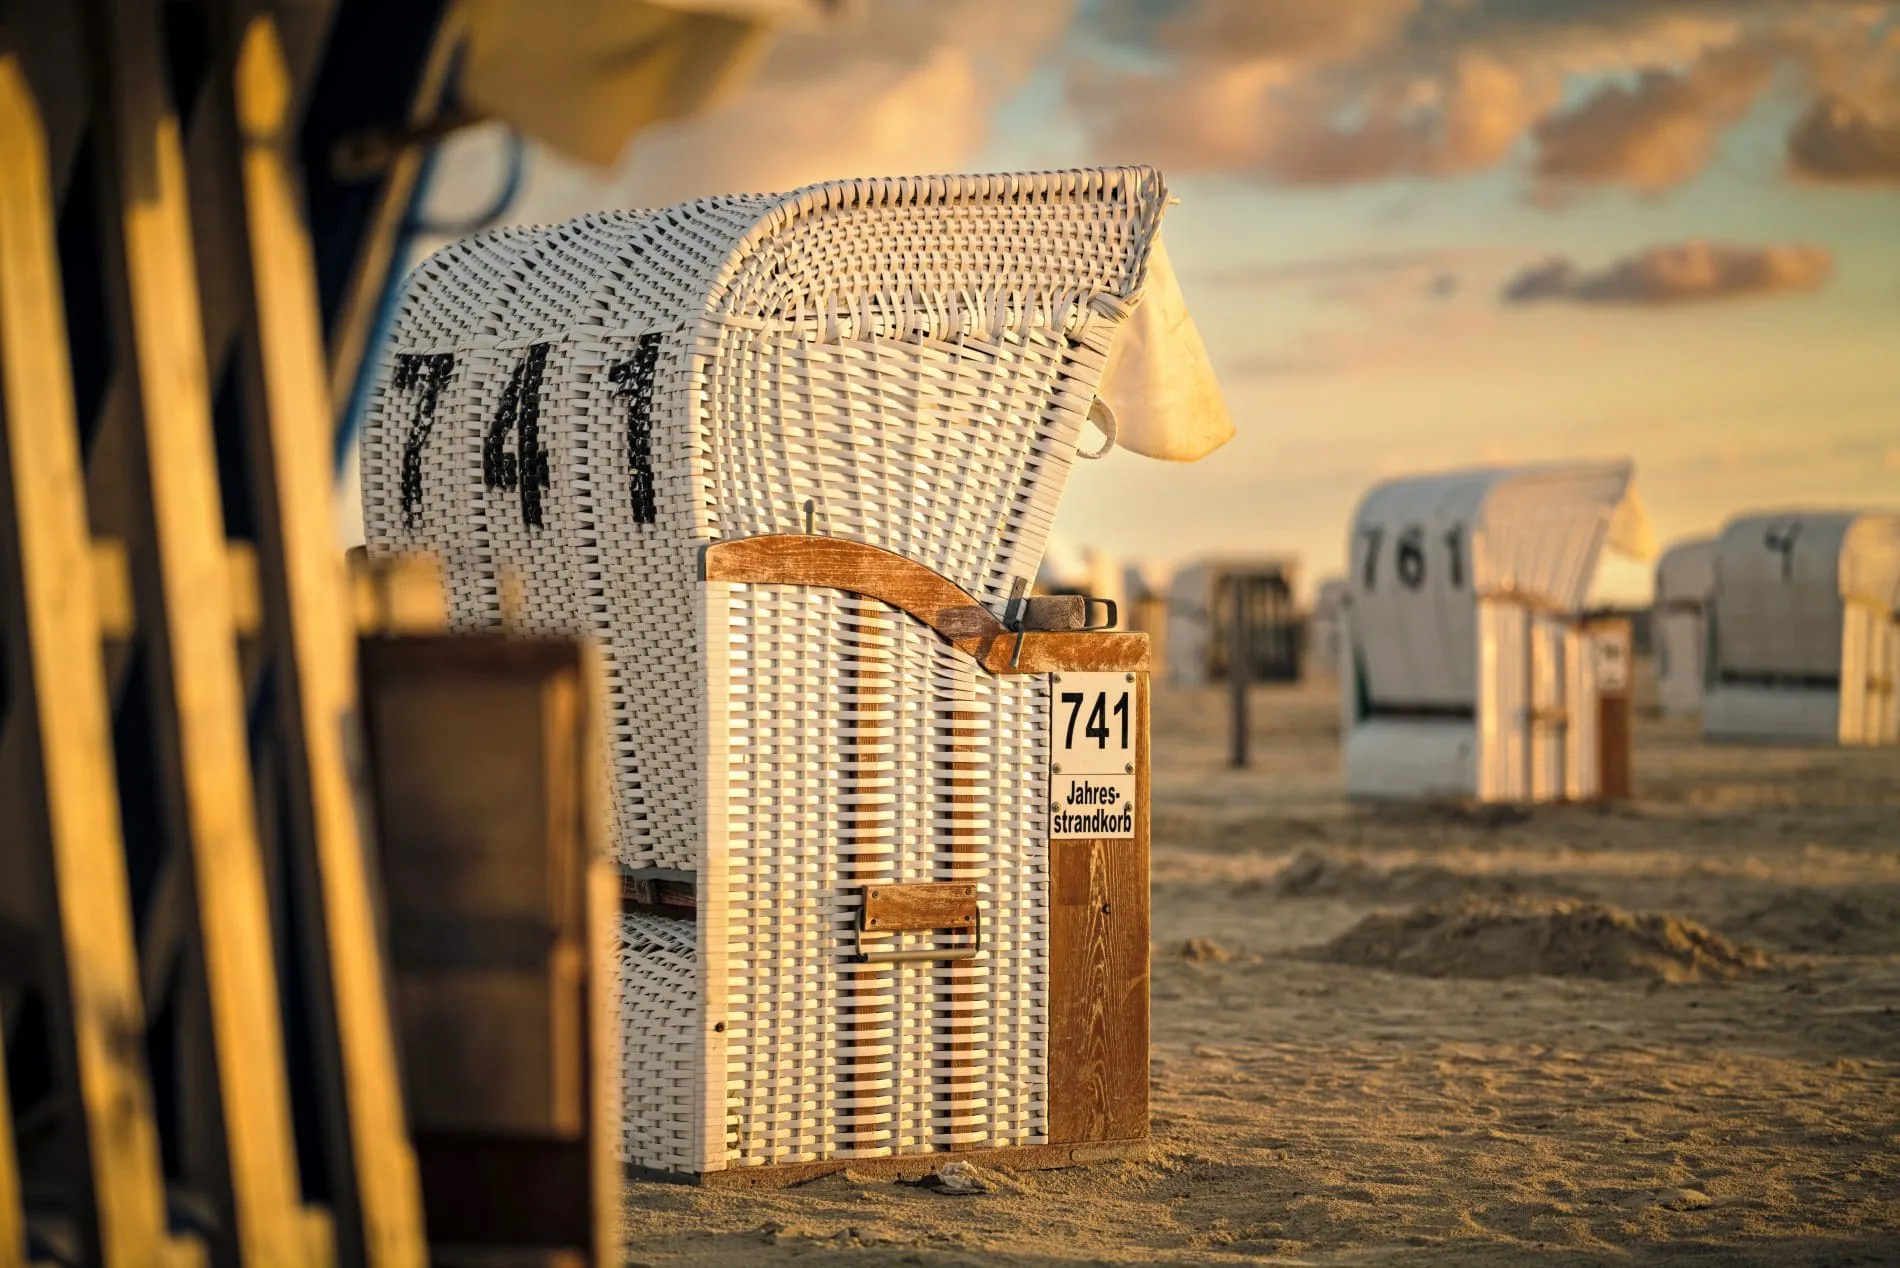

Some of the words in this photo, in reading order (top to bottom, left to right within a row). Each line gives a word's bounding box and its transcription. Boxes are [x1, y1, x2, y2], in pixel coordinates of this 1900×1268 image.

[394, 331, 663, 530] 741
[1359, 520, 1464, 591] 761
[1061, 691, 1129, 749] 741
[1053, 808, 1132, 833] strandkorb
[1066, 780, 1120, 805] Jahres-
